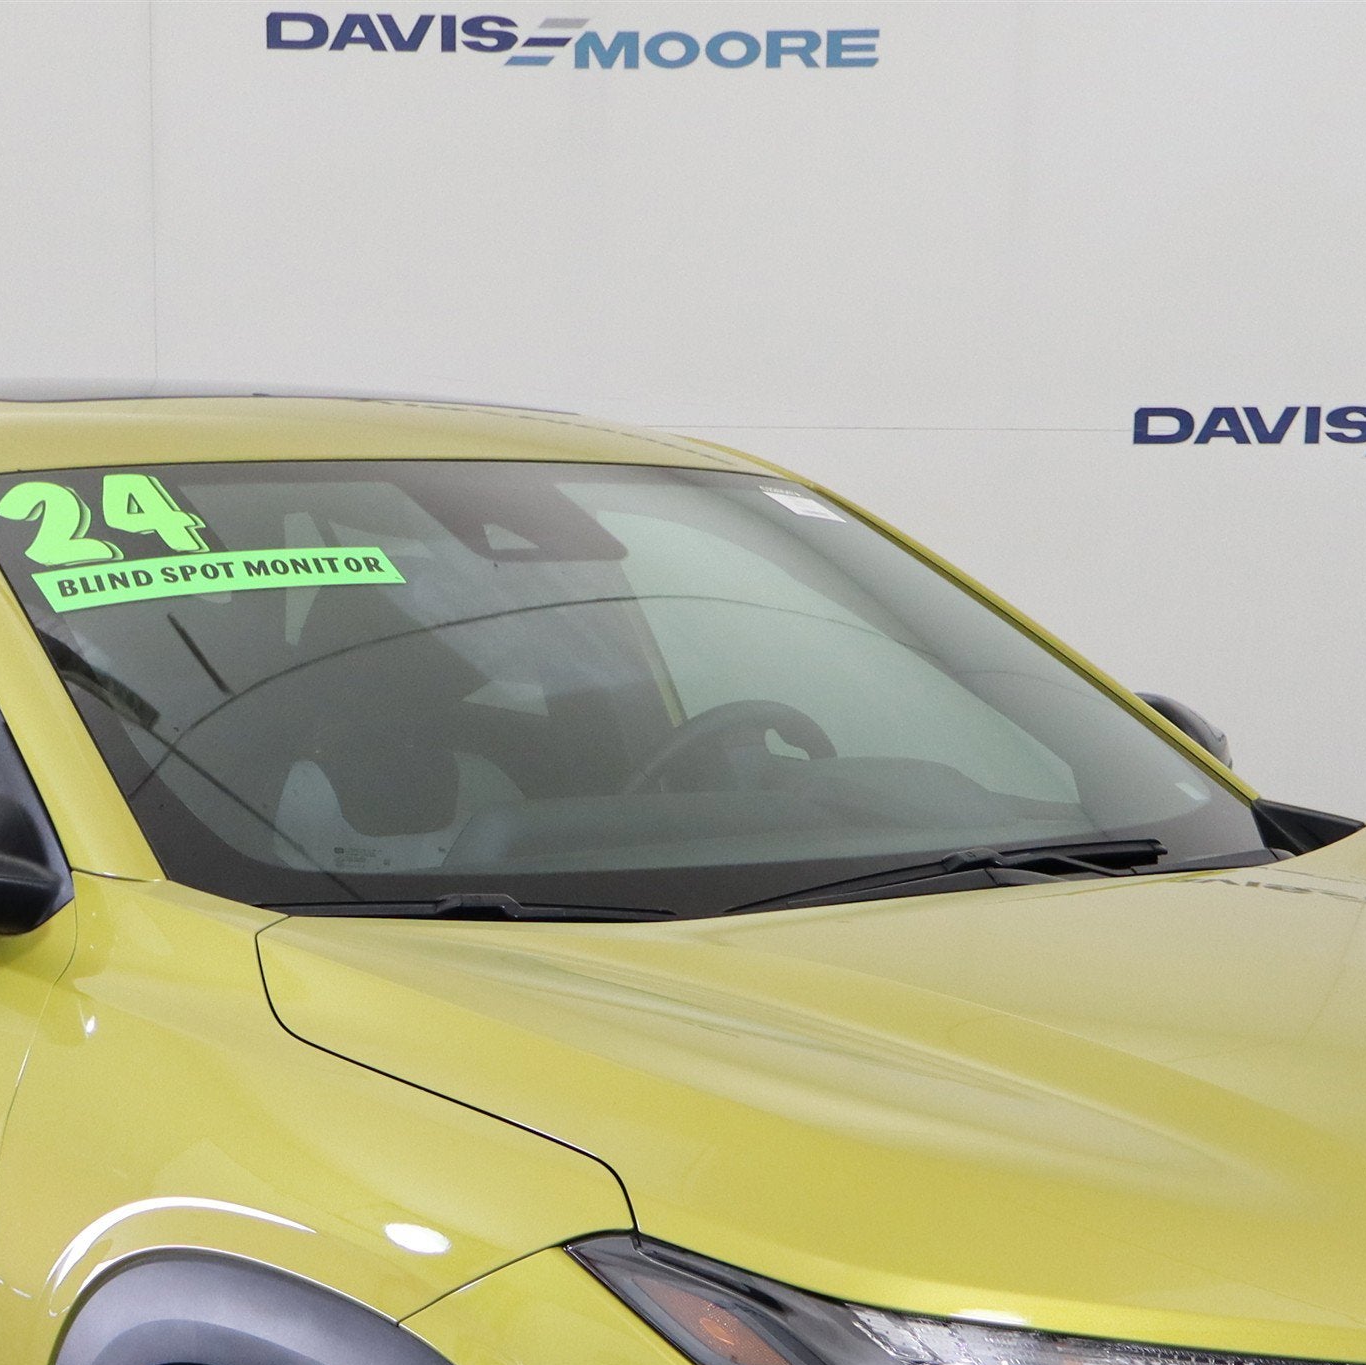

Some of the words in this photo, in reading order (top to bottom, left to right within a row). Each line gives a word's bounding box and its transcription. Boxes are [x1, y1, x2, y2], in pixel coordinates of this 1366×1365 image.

[266, 11, 519, 53] DAVIS
[574, 28, 881, 70] MOORE
[57, 569, 154, 598] BLIND
[163, 561, 235, 583] SPOT
[244, 555, 386, 578] MONITOR
